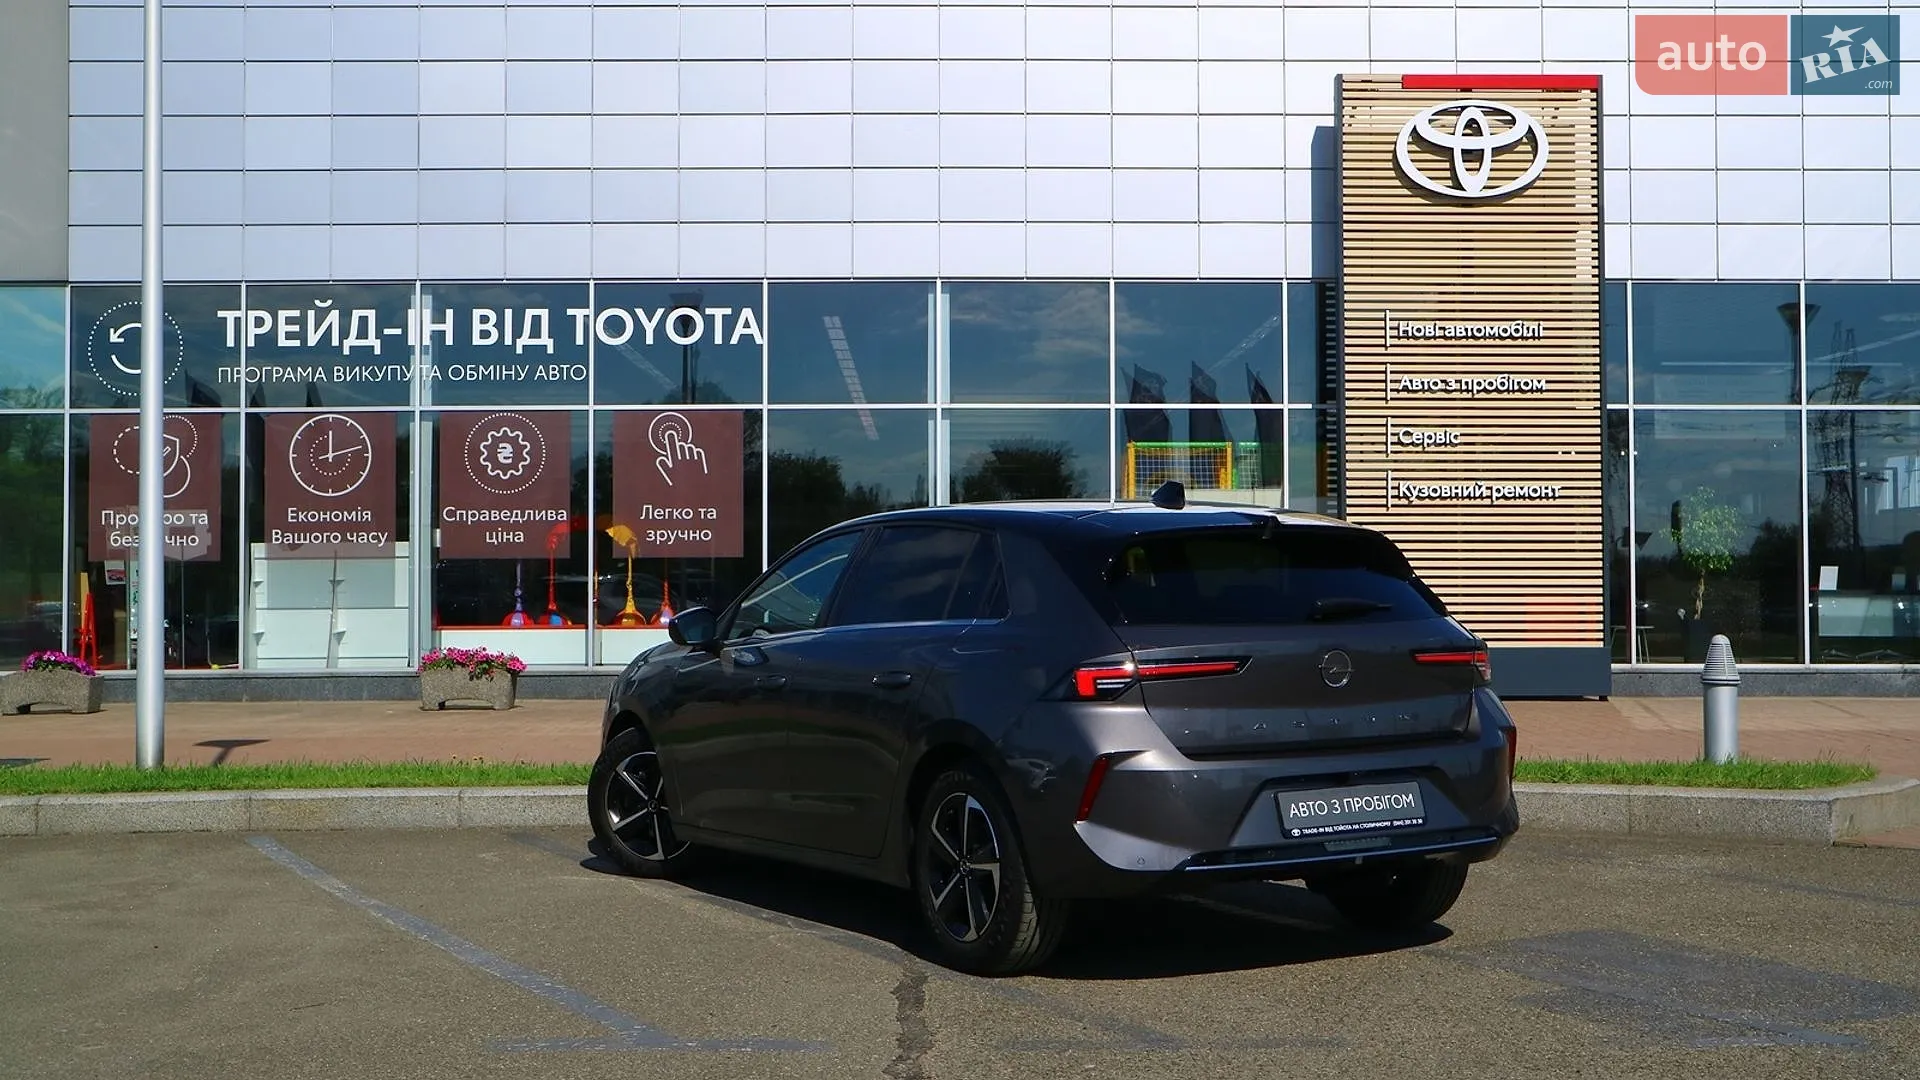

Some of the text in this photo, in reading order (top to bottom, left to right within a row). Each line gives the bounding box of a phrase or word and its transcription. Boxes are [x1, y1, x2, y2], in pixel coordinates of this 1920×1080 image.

[217, 299, 764, 355] ТРЕЙД-ІН ВІД TOYOTA
[1398, 321, 1544, 340] Нові автомобілі
[218, 364, 587, 383] ПРОГРАМА ВИКУПУ ТА ОБМІНУ АВТО
[1399, 373, 1546, 396] Авто з пробігом
[1400, 428, 1461, 449] Сервіс
[1399, 481, 1561, 503] Кузовний ремонт
[189, 513, 208, 525] та
[287, 507, 371, 523] Економія
[443, 506, 567, 525] Справедлива
[640, 505, 717, 523] Легко та
[272, 529, 388, 548] Вашого часу
[485, 528, 524, 544] ціна
[646, 529, 712, 545] зручно
[1289, 800, 1328, 818] АВТО
[1343, 793, 1415, 813] ПРОБІГОМ
